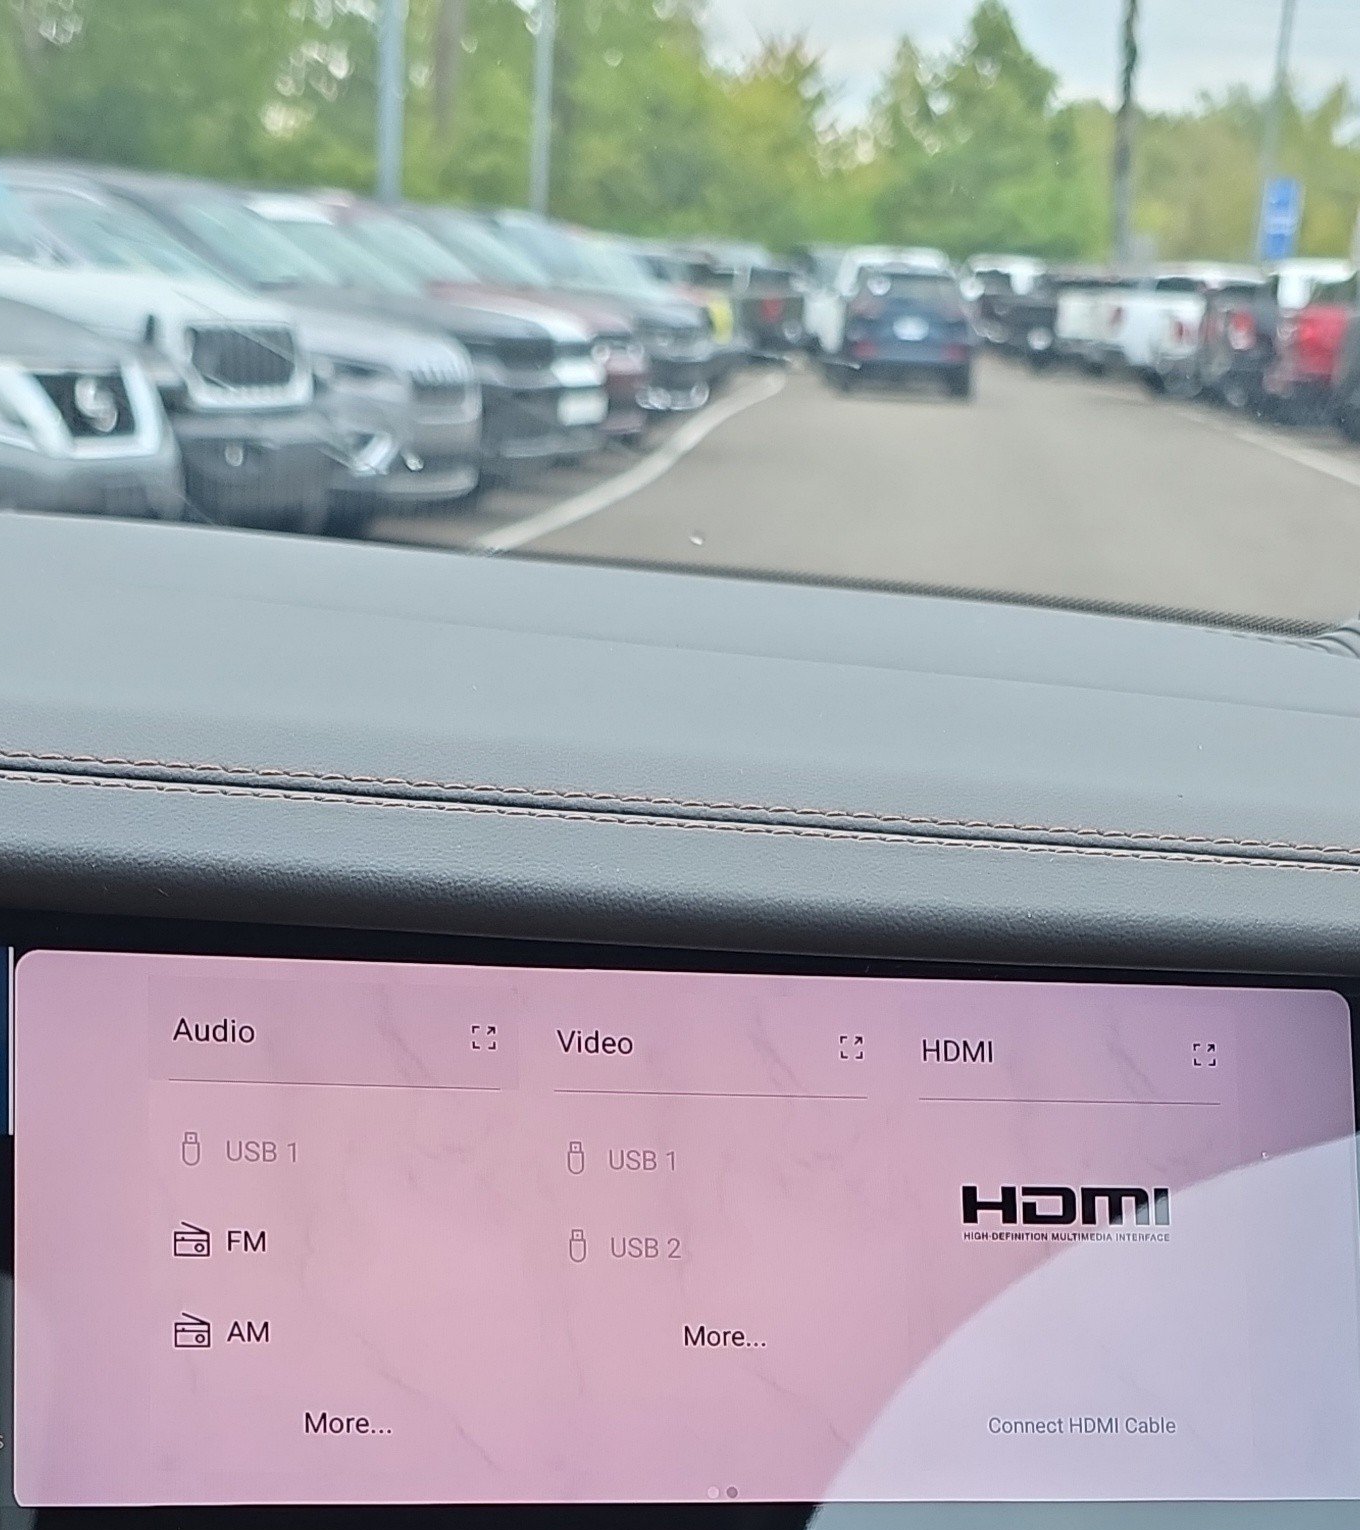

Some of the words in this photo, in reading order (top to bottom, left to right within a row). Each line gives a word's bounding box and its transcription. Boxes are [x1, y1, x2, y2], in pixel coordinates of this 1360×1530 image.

[173, 1019, 256, 1044] Audio
[557, 1030, 634, 1057] Video
[921, 1039, 995, 1064] HDMI
[225, 1141, 278, 1163] USB
[287, 1141, 298, 1163] 1
[608, 1149, 657, 1172] USB
[666, 1149, 677, 1172] 1
[962, 1186, 1169, 1225] HDMI
[226, 1231, 267, 1254] FM
[610, 1237, 659, 1259] USB
[668, 1237, 682, 1259] 2
[963, 1232, 1048, 1242] HIGH-DEFINITION
[1051, 1232, 1112, 1242] MULTIMEDIA
[1116, 1233, 1170, 1242] INTERFACE
[226, 1322, 270, 1344] AM
[683, 1325, 767, 1349] More...
[303, 1412, 393, 1436] More...
[988, 1416, 1063, 1435] Connect
[1069, 1416, 1119, 1435] HDMI
[1124, 1416, 1176, 1436] Cable
